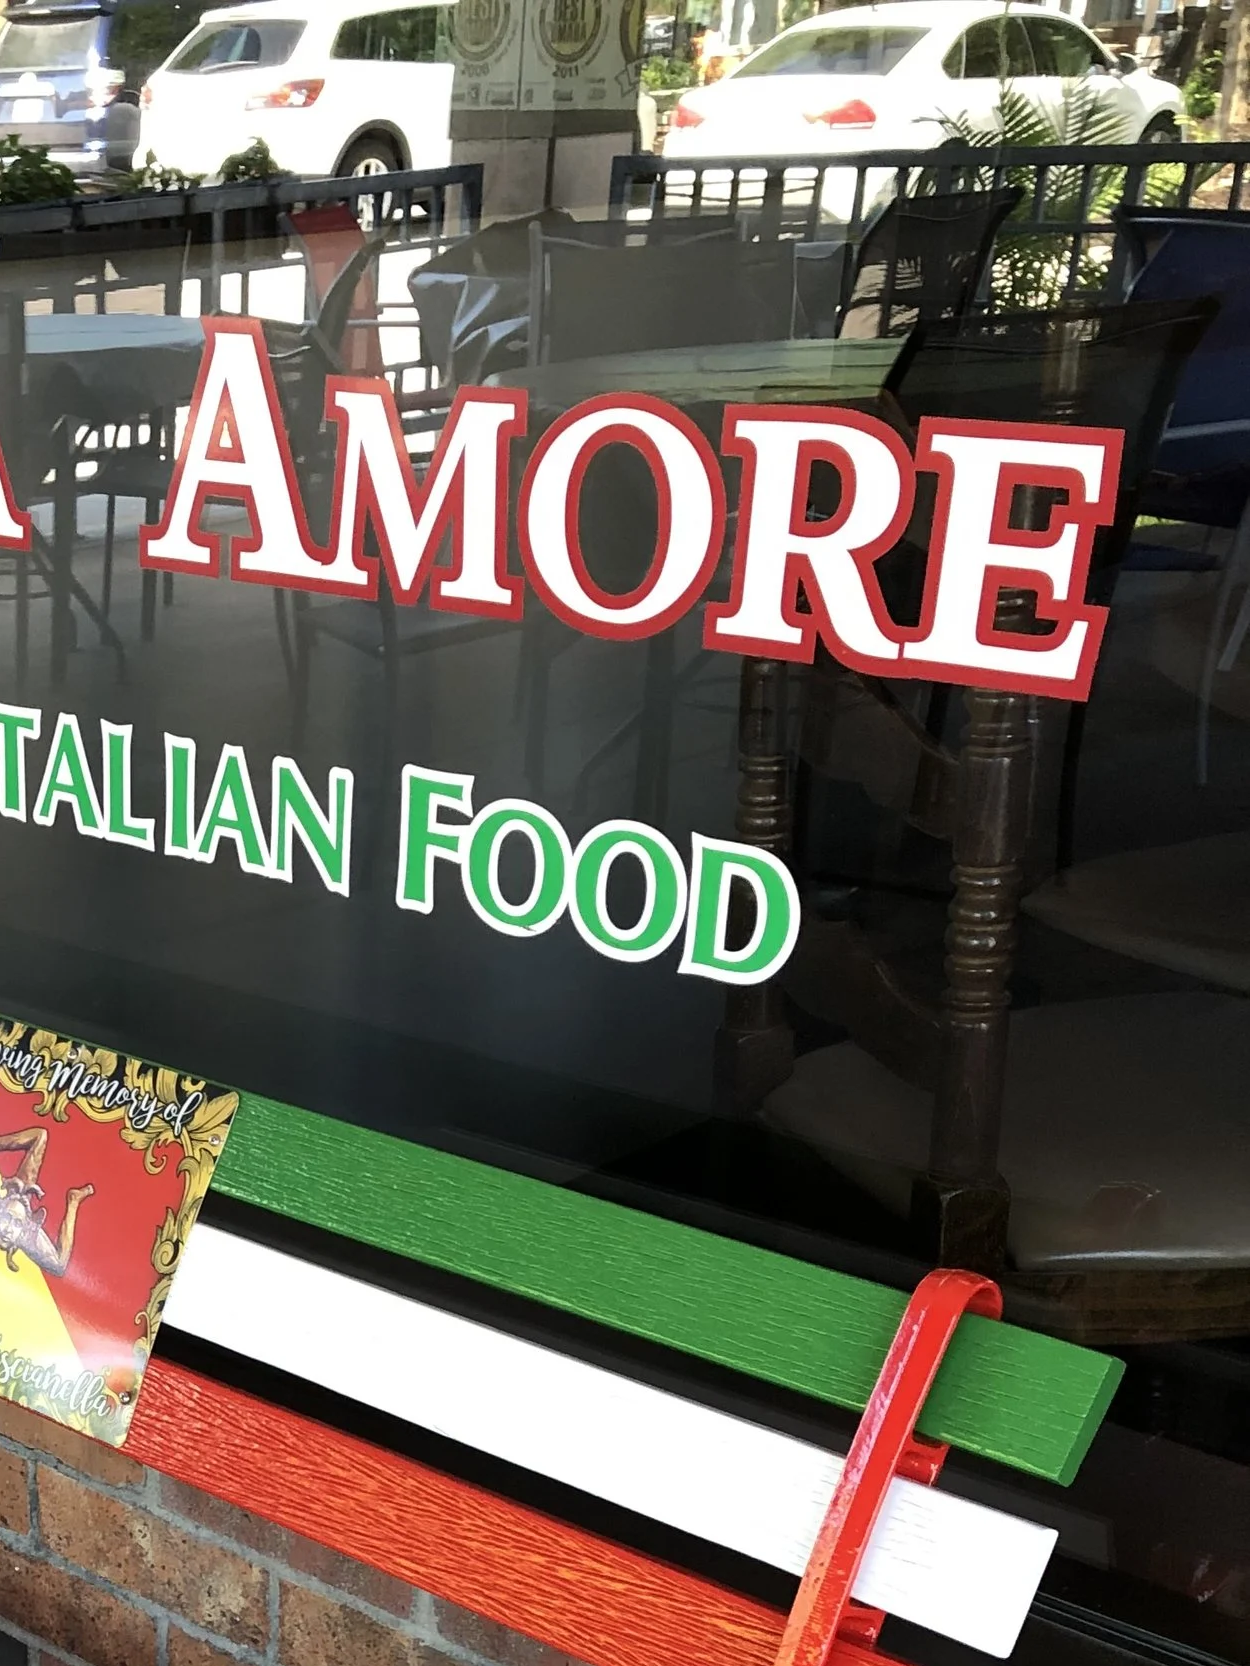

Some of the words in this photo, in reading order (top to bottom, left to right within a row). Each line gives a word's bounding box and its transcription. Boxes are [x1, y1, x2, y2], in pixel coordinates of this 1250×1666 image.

[140, 316, 1124, 702] AMORE
[396, 763, 801, 986] FOOD
[47, 1059, 162, 1130] Memory
[163, 1091, 204, 1137] of
